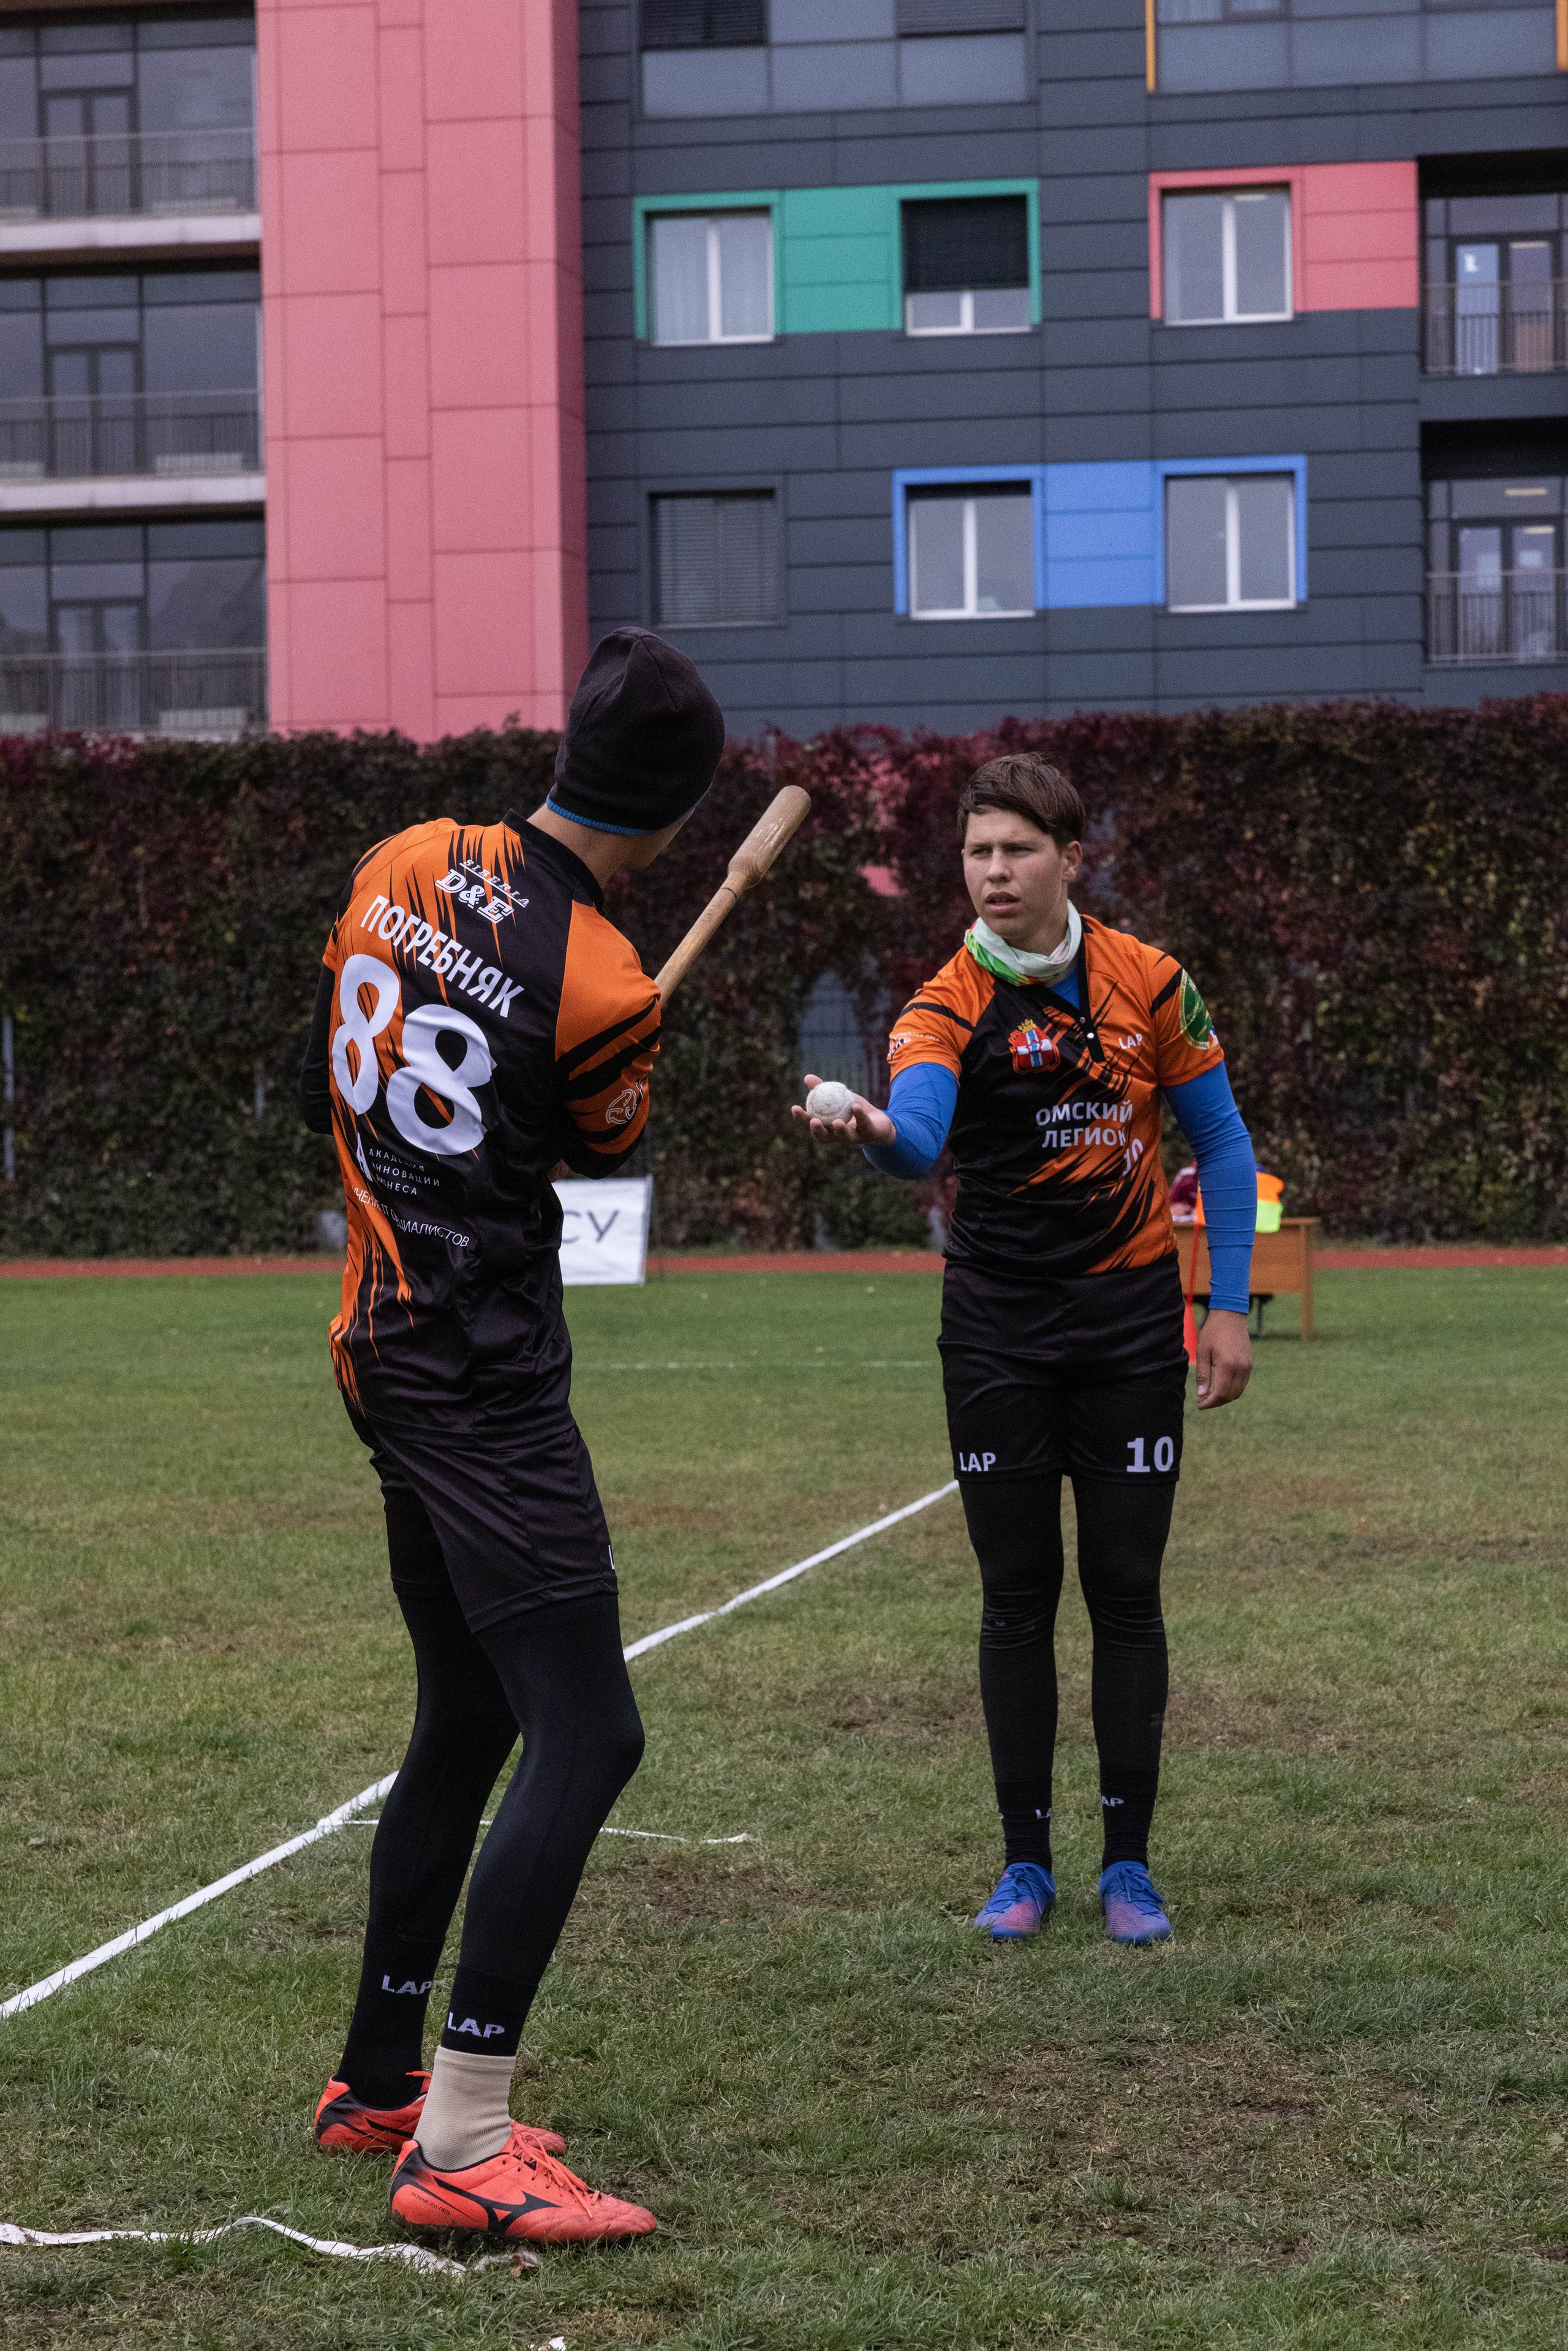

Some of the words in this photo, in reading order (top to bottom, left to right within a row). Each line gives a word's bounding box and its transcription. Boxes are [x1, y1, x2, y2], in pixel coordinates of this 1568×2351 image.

[435, 869, 514, 924] D&E
[463, 859, 530, 907] SIBERIA
[360, 894, 525, 1018] ПОГРЕБНЯК
[332, 954, 497, 1155] 88
[1118, 1033, 1142, 1049] LAP
[1036, 1100, 1133, 1126] ОМСКИЙ
[959, 1452, 997, 1471] LAP
[1126, 1436, 1174, 1473] 10
[382, 1974, 432, 1994] LAP
[448, 2011, 505, 2039] LAP
